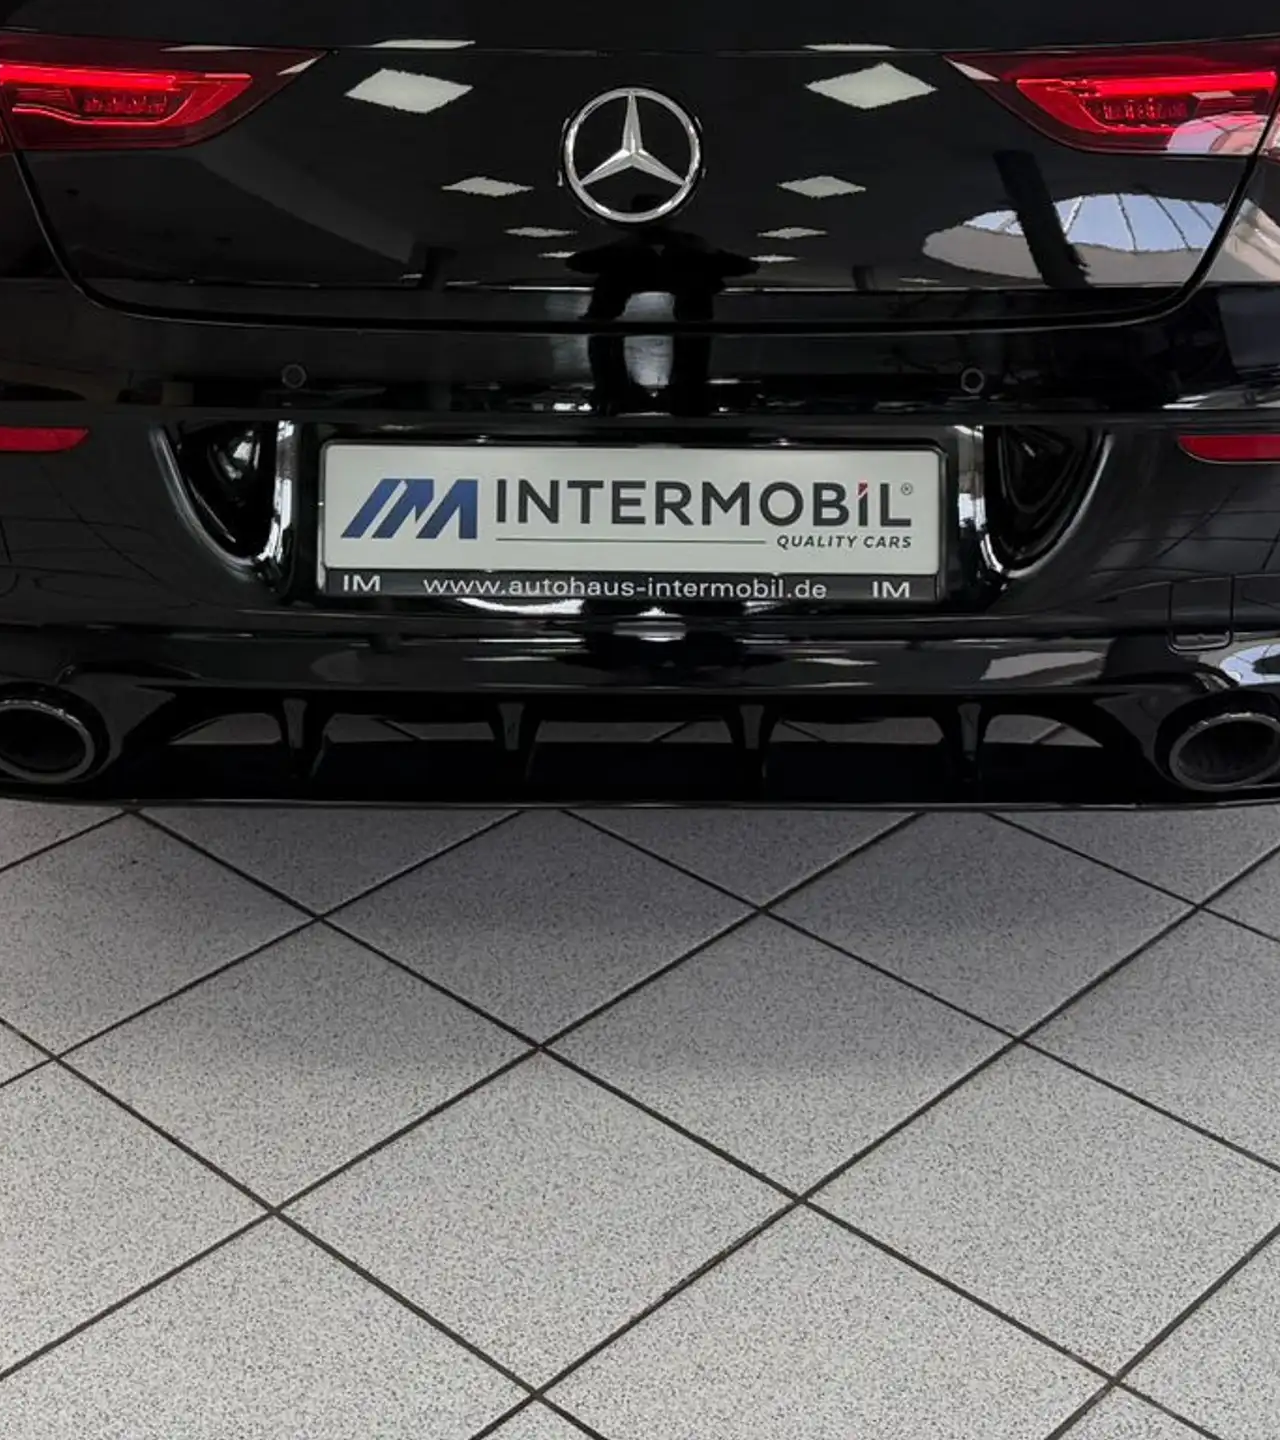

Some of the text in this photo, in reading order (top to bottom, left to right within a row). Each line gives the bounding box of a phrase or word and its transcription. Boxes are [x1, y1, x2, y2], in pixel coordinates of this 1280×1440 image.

[776, 534, 913, 551] QUALITY CARS
[343, 574, 910, 599] IM www.autohaus-intermobil.de IM
